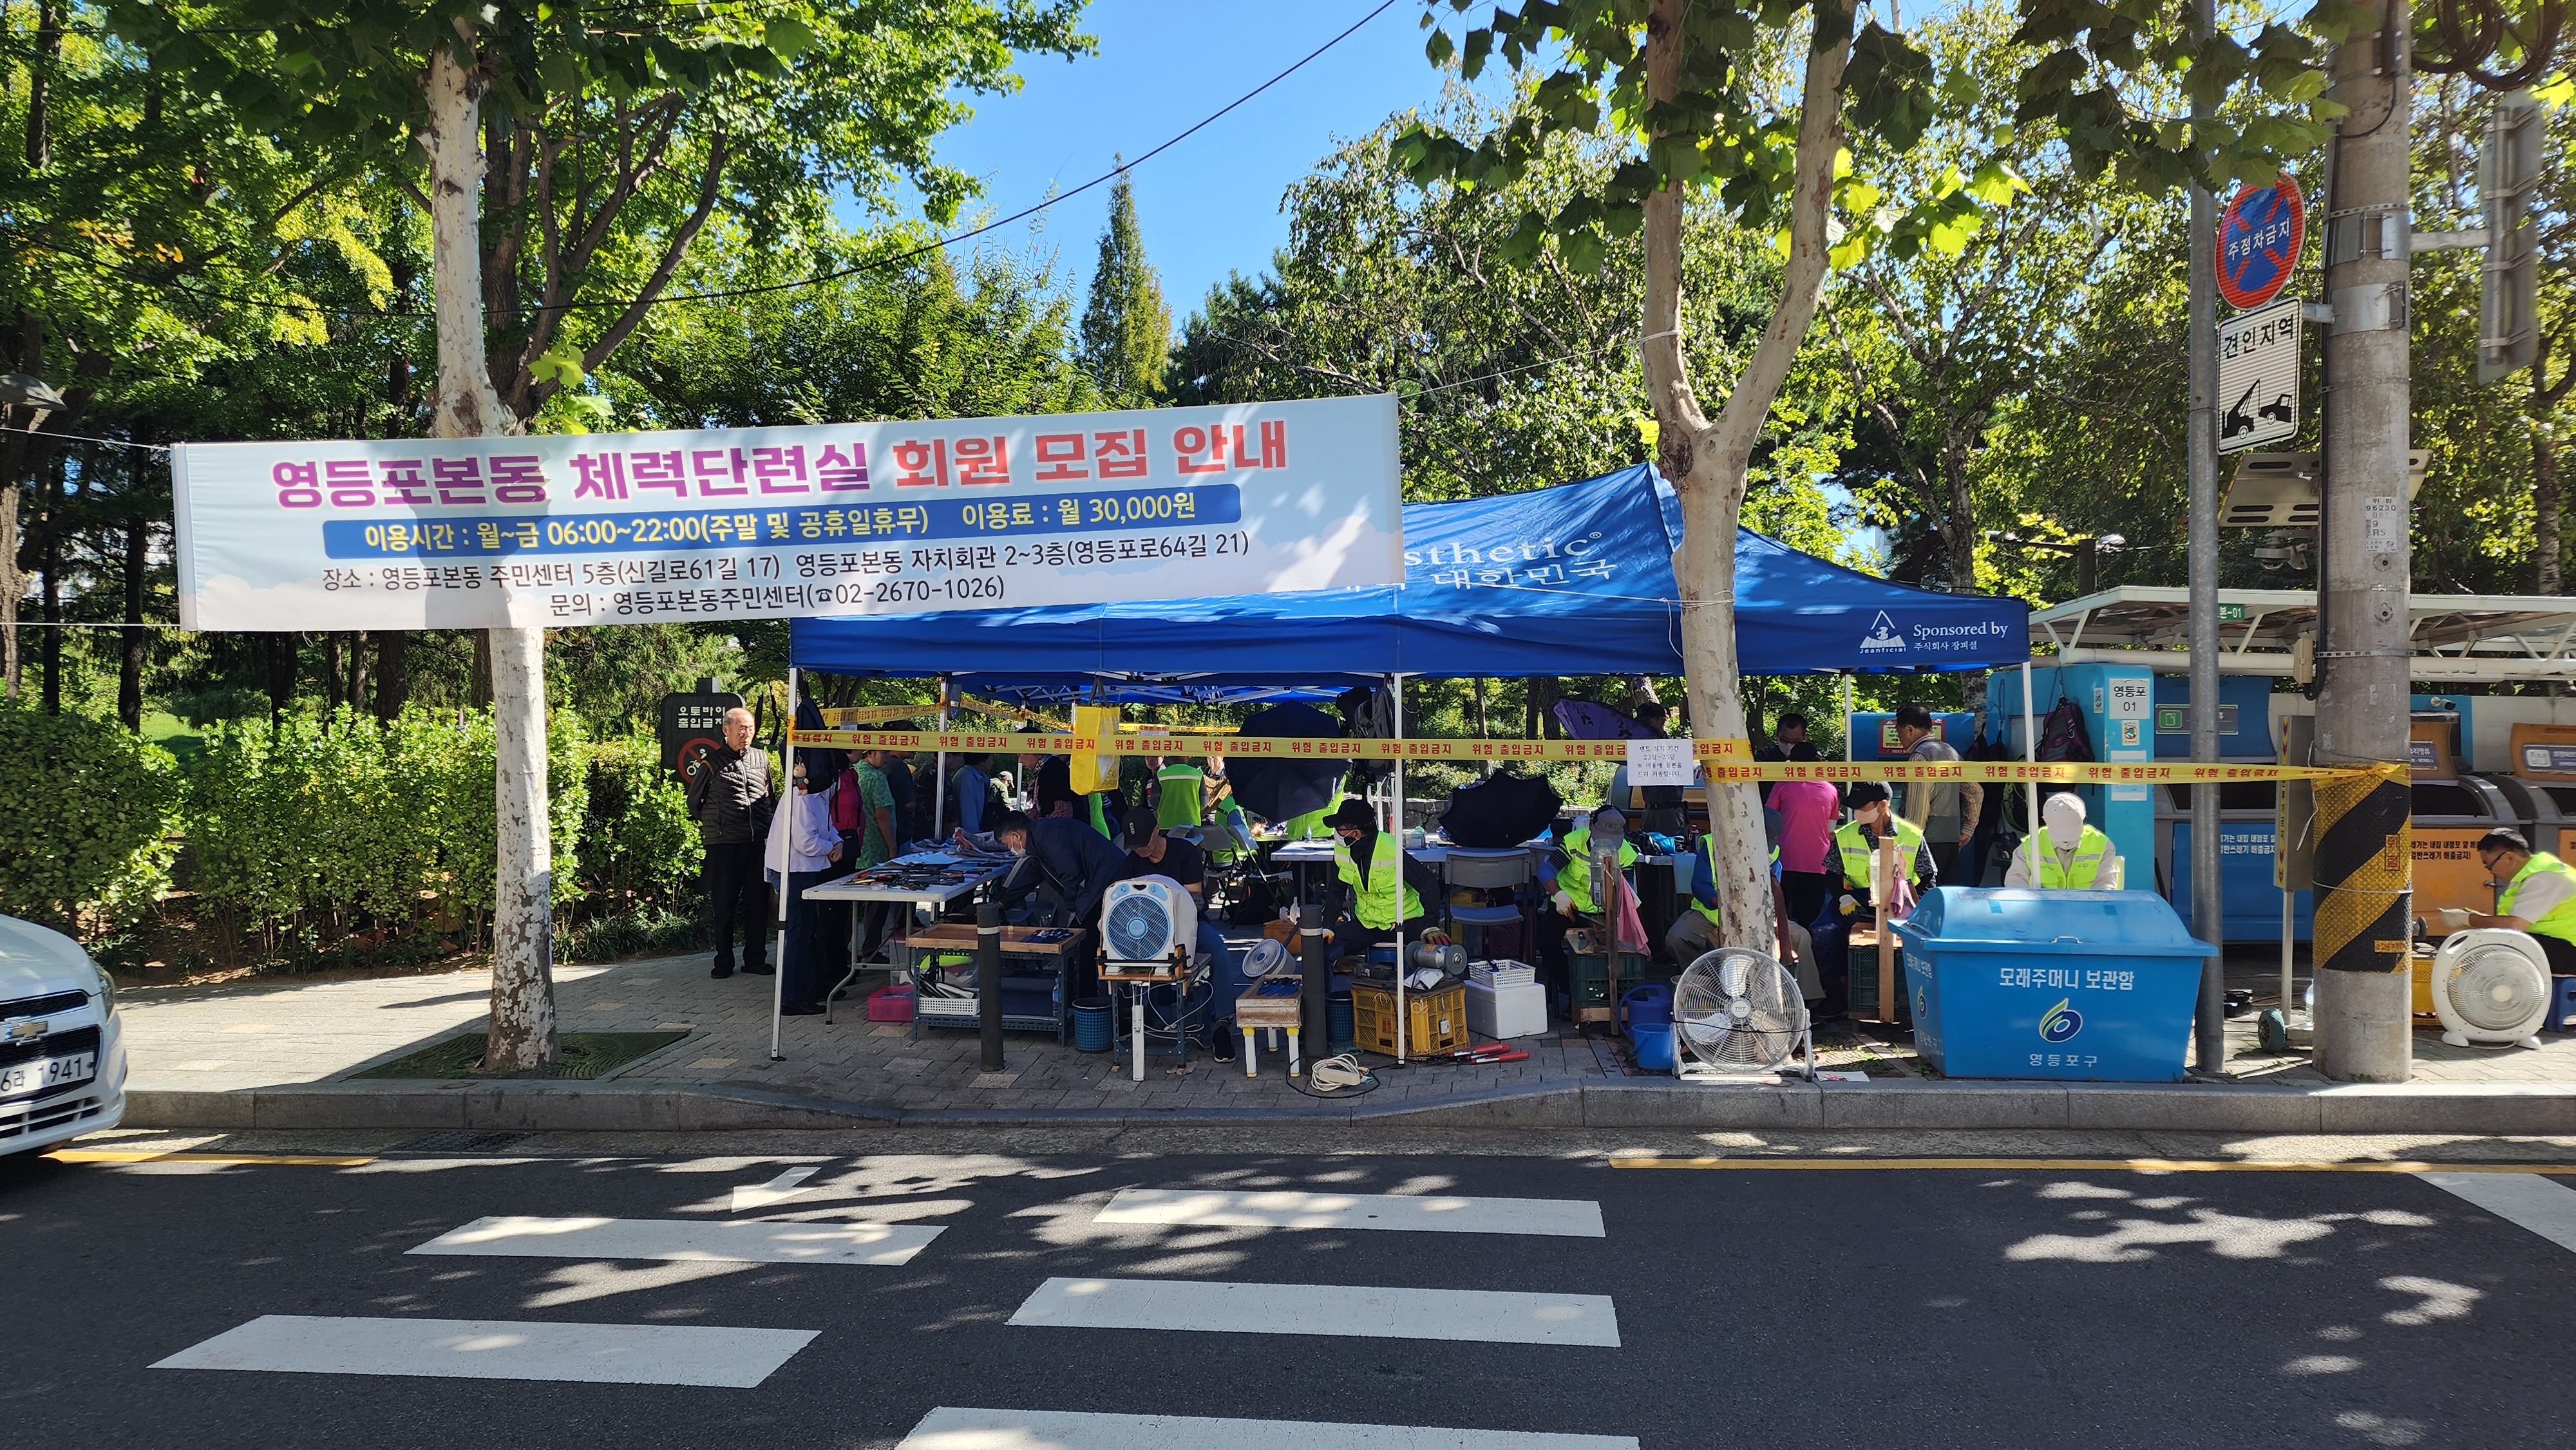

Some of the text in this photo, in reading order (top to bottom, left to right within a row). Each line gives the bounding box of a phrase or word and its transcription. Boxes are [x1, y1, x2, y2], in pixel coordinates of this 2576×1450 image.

[2228, 225, 2290, 260] 주정차금지
[2223, 314, 2295, 360] 견인지역
[273, 419, 1287, 508] 영등포본동 체력단련실 회원 모집 안내
[365, 524, 454, 552] 이용시간
[475, 520, 540, 549] 월~금
[547, 513, 758, 545] 06:00~22:00(주말
[767, 512, 790, 539] 및
[798, 506, 929, 540] 공휴일휴무)
[961, 500, 1034, 531] 이용료
[1057, 499, 1079, 525] 월
[1088, 493, 1196, 522] 30,000원
[321, 568, 362, 592] 장소
[383, 564, 482, 590] 영등포본동
[489, 561, 573, 588] 주민센터
[582, 556, 737, 585] 5층(신길로61길
[746, 553, 781, 581] 17)
[796, 547, 904, 578] 영등포본동
[911, 545, 996, 573] 자치회관
[1005, 534, 1208, 569] 2~3층(영등포로64길
[1215, 531, 1250, 556] 21)
[1430, 559, 1617, 590] 대한민국
[548, 594, 592, 618] 문의
[1913, 621, 2009, 640] Sponsored by
[1913, 641, 1949, 651] 주식회사
[2114, 686, 2147, 698] 영등포
[677, 706, 726, 717] 오토바이
[2123, 701, 2137, 711] 01
[851, 734, 871, 745] 위험
[878, 735, 920, 746] 출입금지
[939, 736, 959, 748] 위험
[966, 737, 1008, 748] 출입금지
[1027, 737, 1048, 749] 위험
[1054, 738, 1095, 750] 출입금지
[1114, 739, 1135, 751] 위험
[1141, 739, 1184, 752] 출입금지
[1202, 740, 1224, 753] 위험
[1230, 740, 1272, 753] 출입금지
[1291, 741, 1312, 753] 위험
[1318, 742, 1361, 755] 출입금지
[1381, 742, 1402, 755] 위험
[1408, 742, 1452, 755] 출입금지
[1472, 744, 1493, 756] 위험
[1500, 744, 1544, 756] 출입금지
[1564, 744, 1586, 756] 위험
[1593, 744, 1626, 756] 출입금
[1717, 766, 1763, 778] 출입금지
[1784, 767, 1807, 778] 위험
[1814, 766, 1862, 778] 출입금지
[1883, 766, 1907, 778] 위험
[1914, 766, 1962, 778] 출입금지
[1985, 766, 2008, 778] 위험
[2016, 766, 2066, 778] 출입금지
[2088, 766, 2112, 779] 위험
[2120, 766, 2171, 779] 출입금지
[2193, 768, 2219, 778] 위험
[2226, 767, 2280, 778] 출입금지
[2220, 834, 2235, 843] 기는
[2237, 834, 2249, 843] 내집
[2430, 841, 2441, 849] 내집
[2462, 841, 2469, 849] 앞
[2220, 845, 2249, 854] 반쓰레기
[1999, 968, 2136, 991] 모래주머니 보관함
[2029, 1053, 2098, 1068] 영등포구
[37, 1057, 82, 1086] 1941
